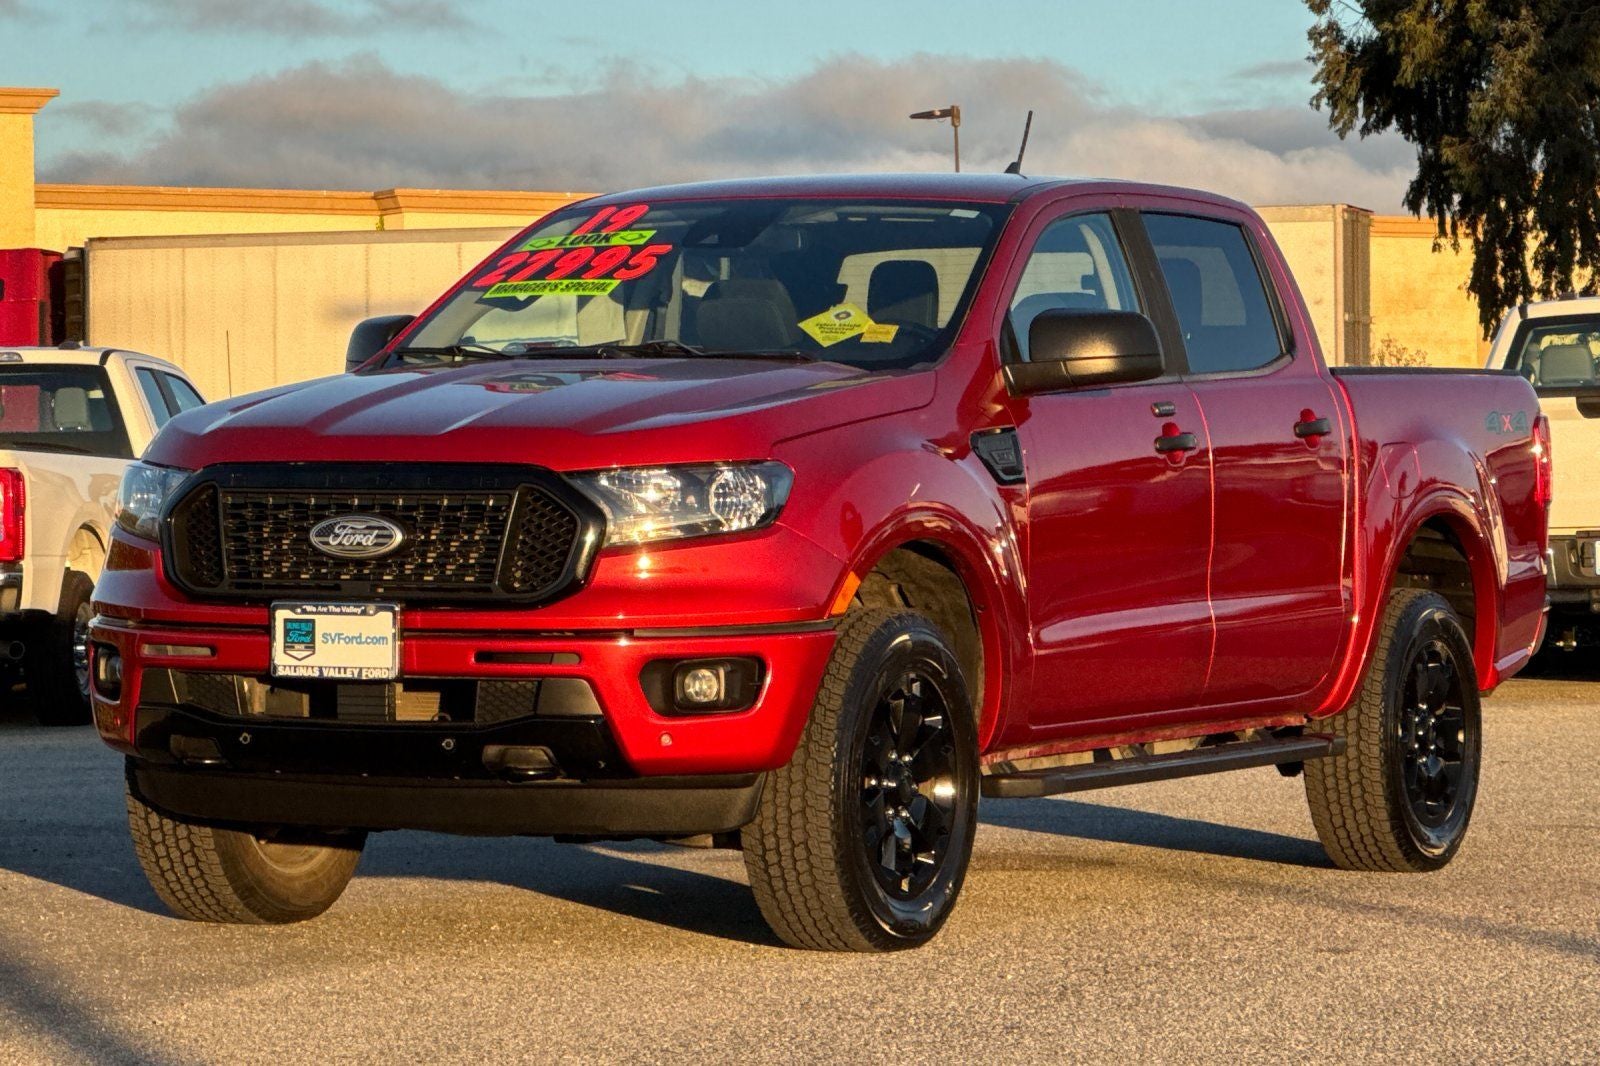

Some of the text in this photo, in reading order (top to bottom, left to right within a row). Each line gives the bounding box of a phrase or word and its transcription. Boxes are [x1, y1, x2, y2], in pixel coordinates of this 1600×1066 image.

[572, 204, 649, 235] 19
[556, 233, 618, 247] LOOK
[472, 244, 673, 287] 27995
[560, 281, 614, 293] SPECIAL
[328, 523, 379, 546] Ford
[287, 630, 312, 643] Ford
[321, 632, 389, 645] SVFord.com
[278, 665, 389, 679] SALINAS VALLEY FORD
